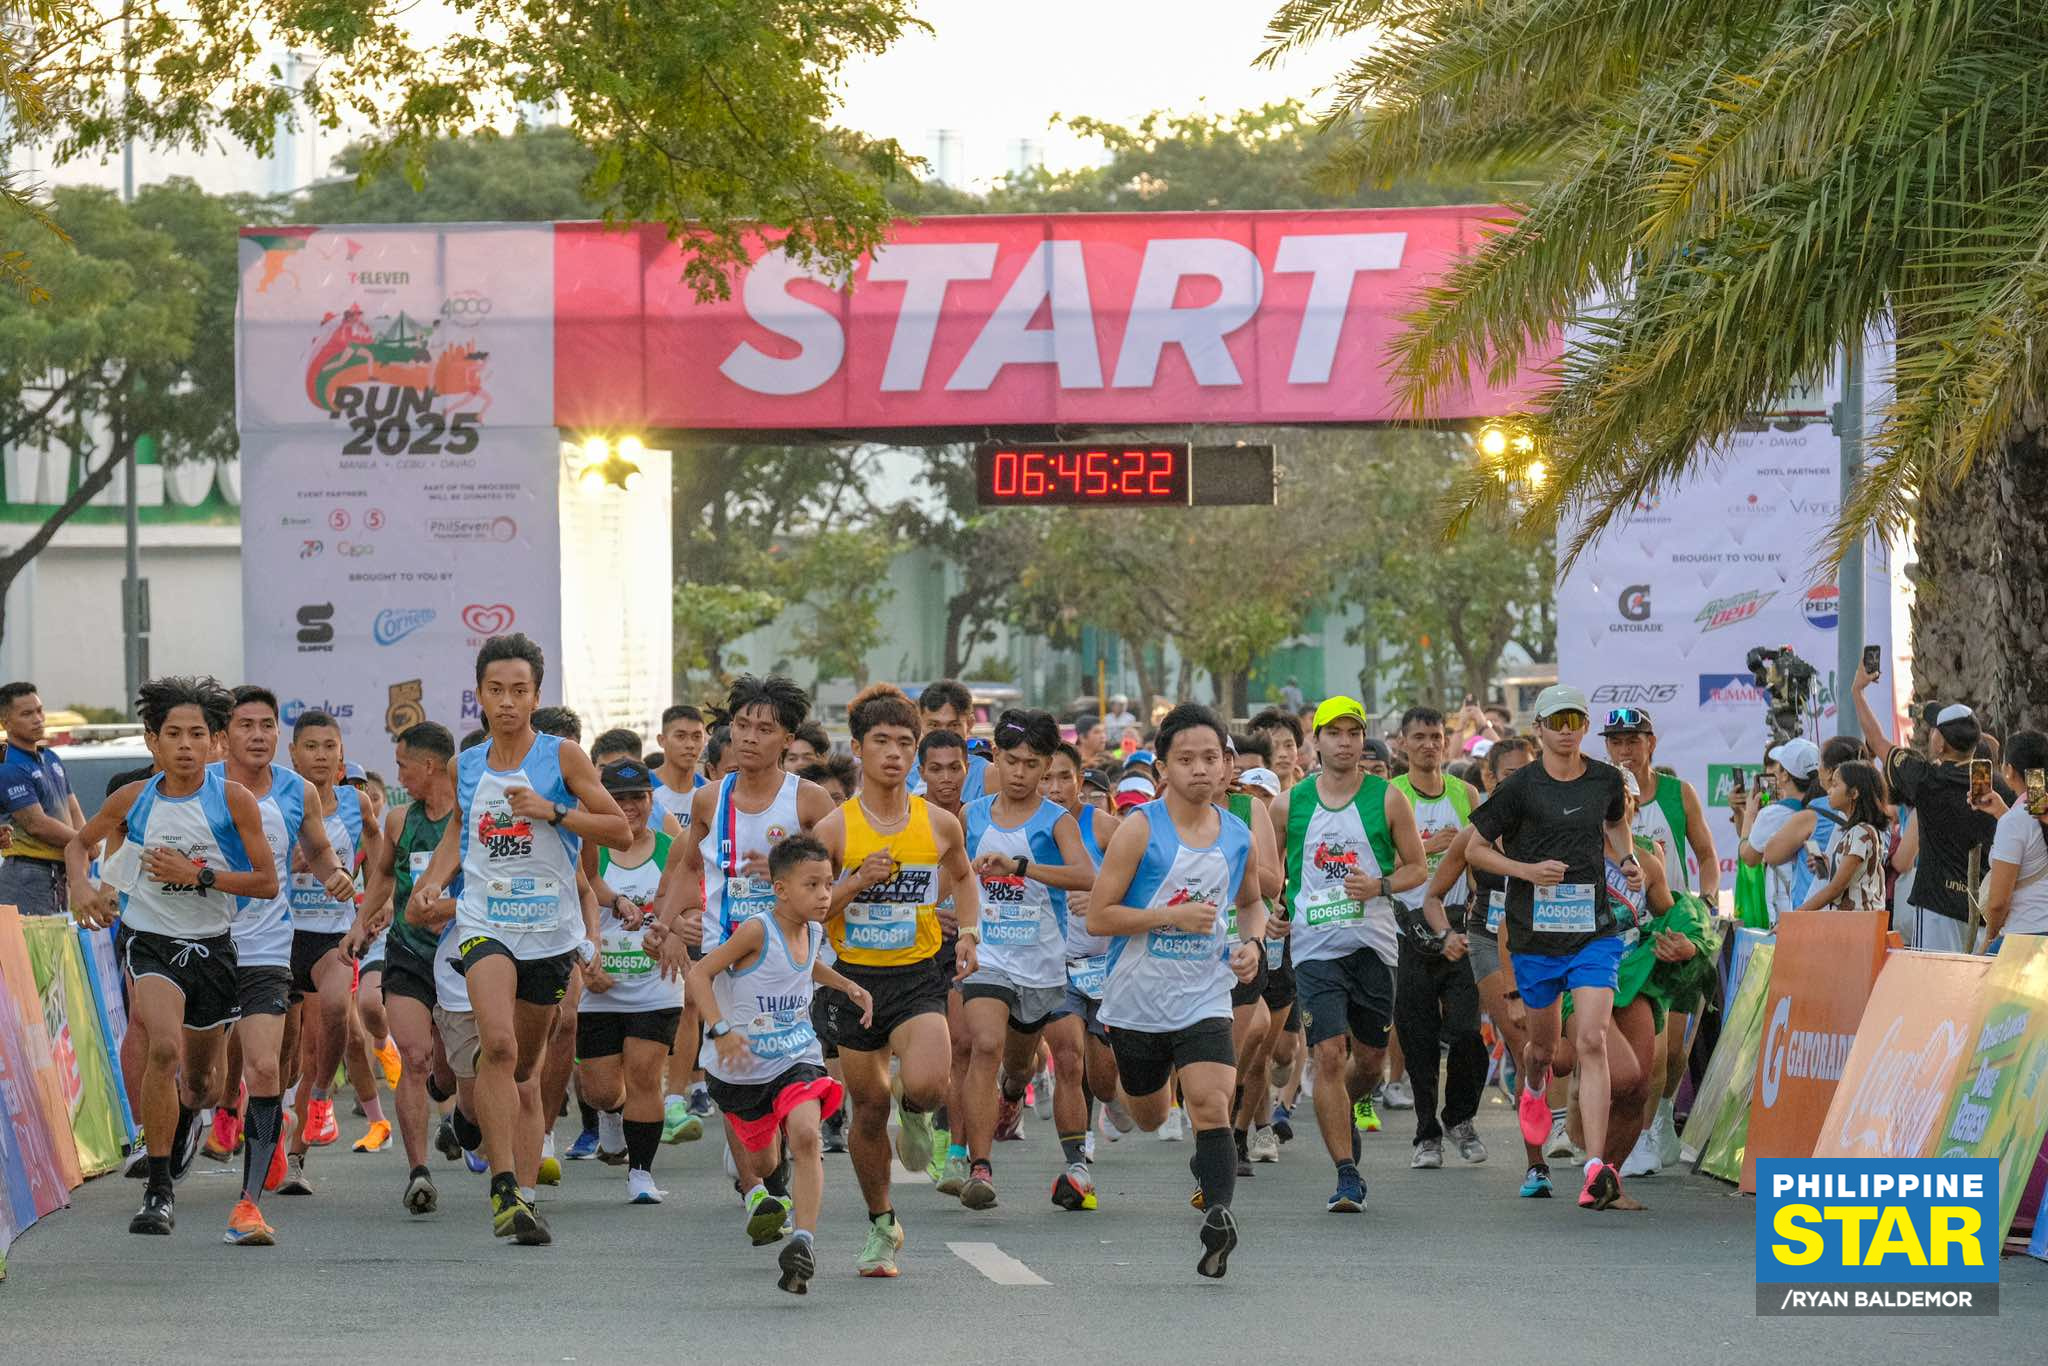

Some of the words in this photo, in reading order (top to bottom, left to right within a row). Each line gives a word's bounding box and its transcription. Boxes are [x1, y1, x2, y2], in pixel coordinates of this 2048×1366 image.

[719, 231, 1408, 396] START
[329, 386, 433, 420] RUN
[342, 412, 480, 456] 2025
[1769, 437, 1807, 446] DAVAO
[993, 451, 1173, 496] 06:45:22
[1757, 468, 1784, 476] HOTEL
[1787, 467, 1831, 475] PARTNERS
[1672, 554, 1722, 563] BROUGHT
[1725, 554, 1740, 562] TO
[1743, 554, 1765, 562] YOU
[1768, 553, 1781, 562] BY
[349, 573, 397, 582] BROUGHT
[400, 573, 413, 581] TO
[417, 573, 437, 581] YOU
[441, 573, 453, 581] BY
[1805, 602, 1839, 613] PEPS
[1609, 624, 1663, 632] GATORADE
[1591, 684, 1678, 703] STING
[488, 835, 515, 847] RUN
[489, 841, 531, 858] 2025
[1322, 862, 1346, 871] RUN
[901, 871, 928, 879] TEAM
[1325, 869, 1348, 880] 202
[162, 882, 198, 892] 202
[985, 882, 1011, 891] RUN
[988, 890, 1024, 901] 2025
[1787, 1031, 1857, 1081] GATORAD
